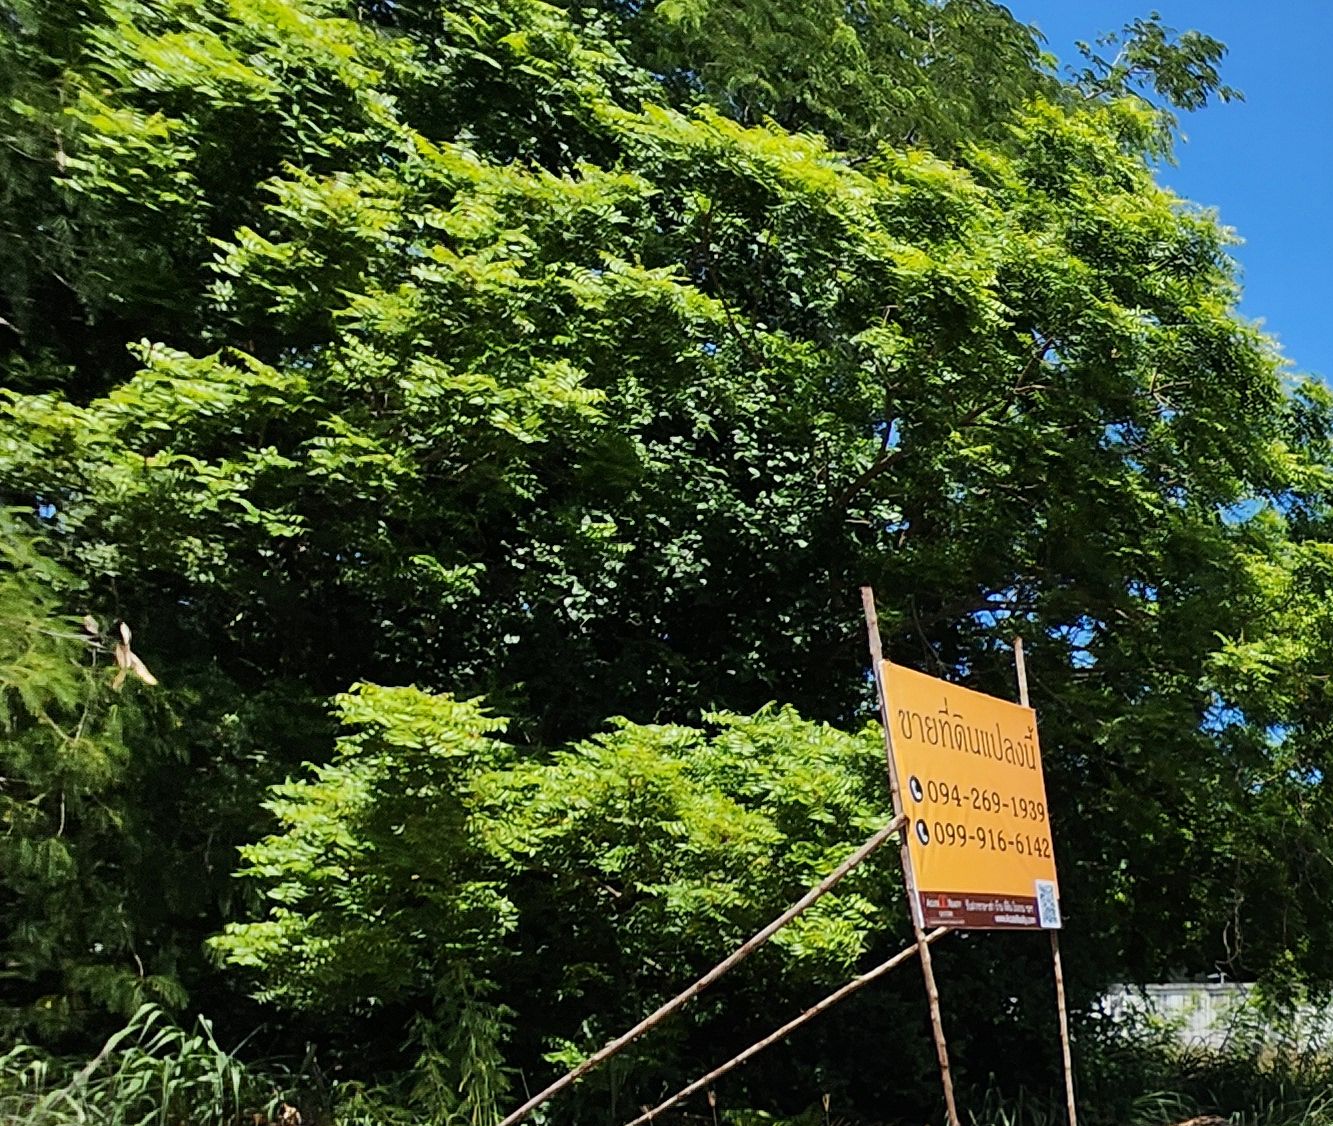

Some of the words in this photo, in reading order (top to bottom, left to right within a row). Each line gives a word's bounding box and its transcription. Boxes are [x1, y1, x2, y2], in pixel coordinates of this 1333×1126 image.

[898, 697, 1036, 770] ขายที่ดินแปลงนี้
[927, 780, 1045, 823] 094-269-1939
[934, 821, 1051, 859] 099-916-6142
